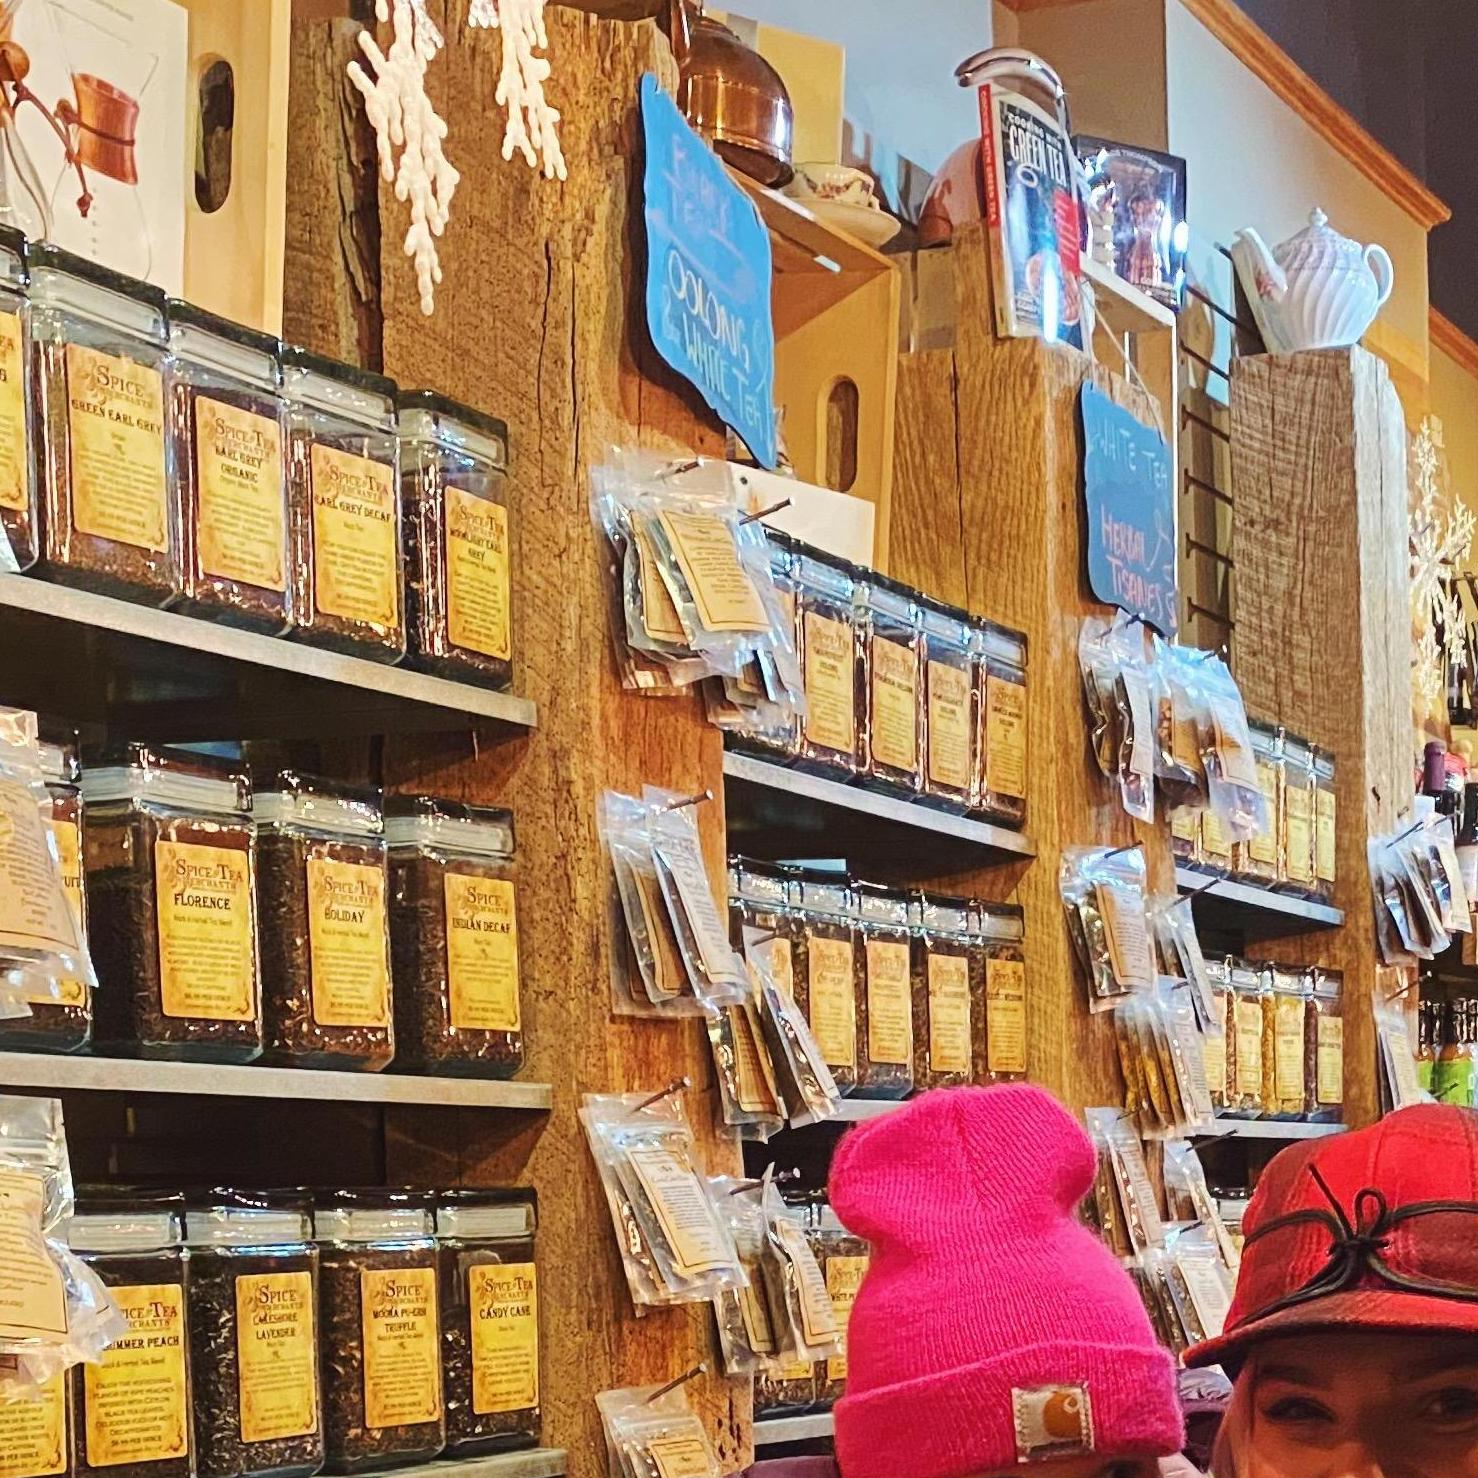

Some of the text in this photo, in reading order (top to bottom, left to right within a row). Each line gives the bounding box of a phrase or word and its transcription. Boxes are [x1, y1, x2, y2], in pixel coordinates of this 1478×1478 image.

[1009, 125, 1047, 174] GREEN
[1046, 144, 1067, 188] TEA
[668, 248, 750, 371] OOLONG
[72, 399, 162, 436] GREEN EARL GREY
[339, 500, 363, 515] GREY
[176, 858, 244, 882] SPICE TEA
[173, 893, 231, 910] FLORENCE
[483, 920, 511, 935] DECAF
[258, 1285, 297, 1303] SPICE
[385, 1279, 422, 1298] SPICE
[150, 1302, 178, 1319] TEA
[479, 1306, 509, 1321] CANDY
[147, 1335, 180, 1348] PEACH
